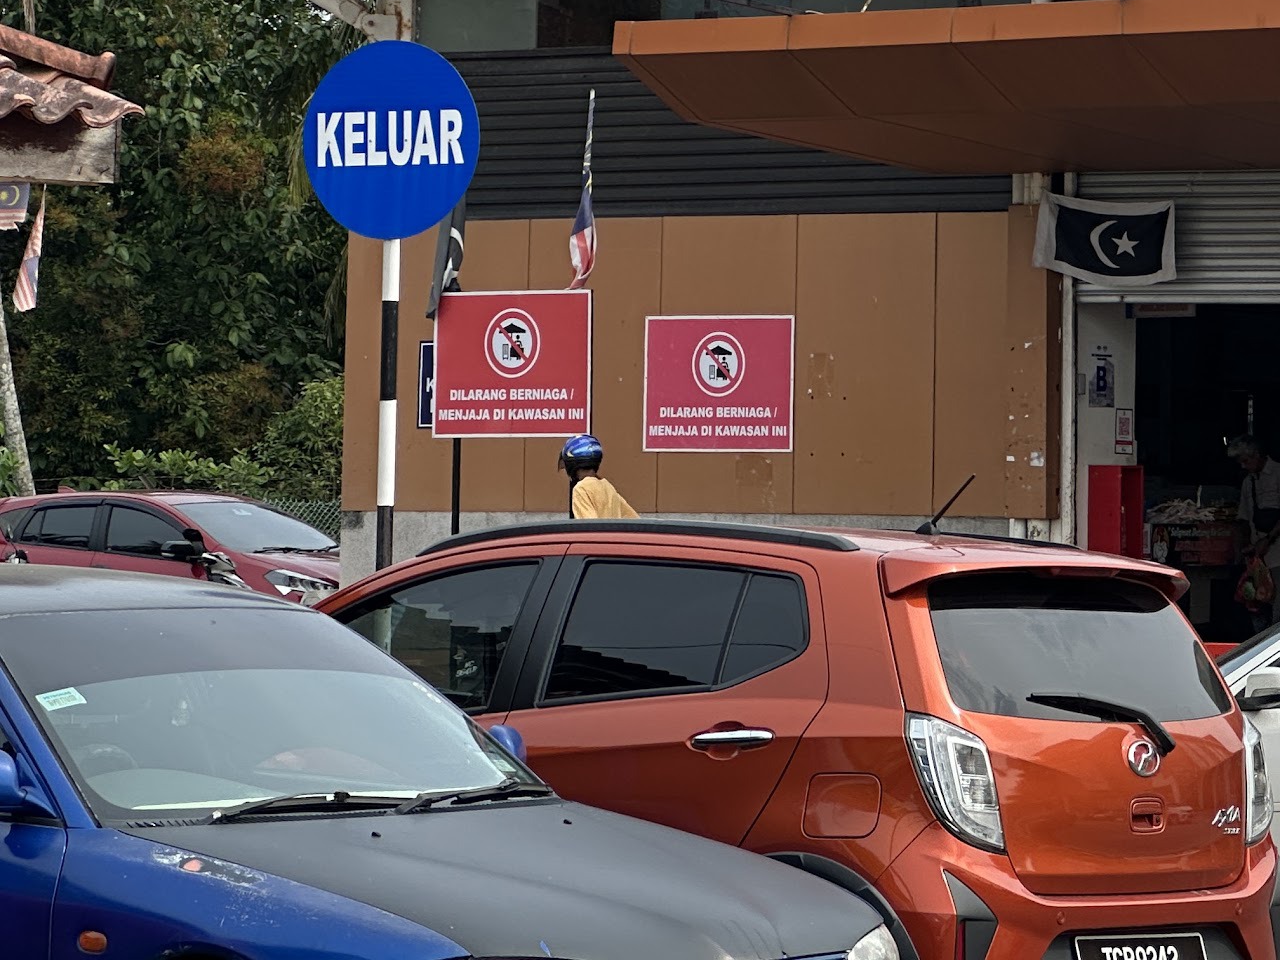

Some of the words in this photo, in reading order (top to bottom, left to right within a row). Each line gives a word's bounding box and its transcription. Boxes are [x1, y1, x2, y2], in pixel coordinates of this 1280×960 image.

[317, 109, 464, 167] KELUAR
[1096, 365, 1107, 392] B
[450, 389, 506, 401] DILARANG
[510, 388, 567, 400] BERNIAGA
[438, 408, 490, 421] MENJAJA
[493, 409, 504, 420] DI
[508, 408, 565, 420] KAWASAN
[568, 408, 584, 420] INI
[660, 407, 713, 418] DILARANG
[716, 407, 771, 418] BERNIAGA
[649, 425, 698, 436] MENJAJA
[701, 425, 712, 436] DI
[715, 425, 769, 436] KAWASAN
[772, 425, 787, 436] INI
